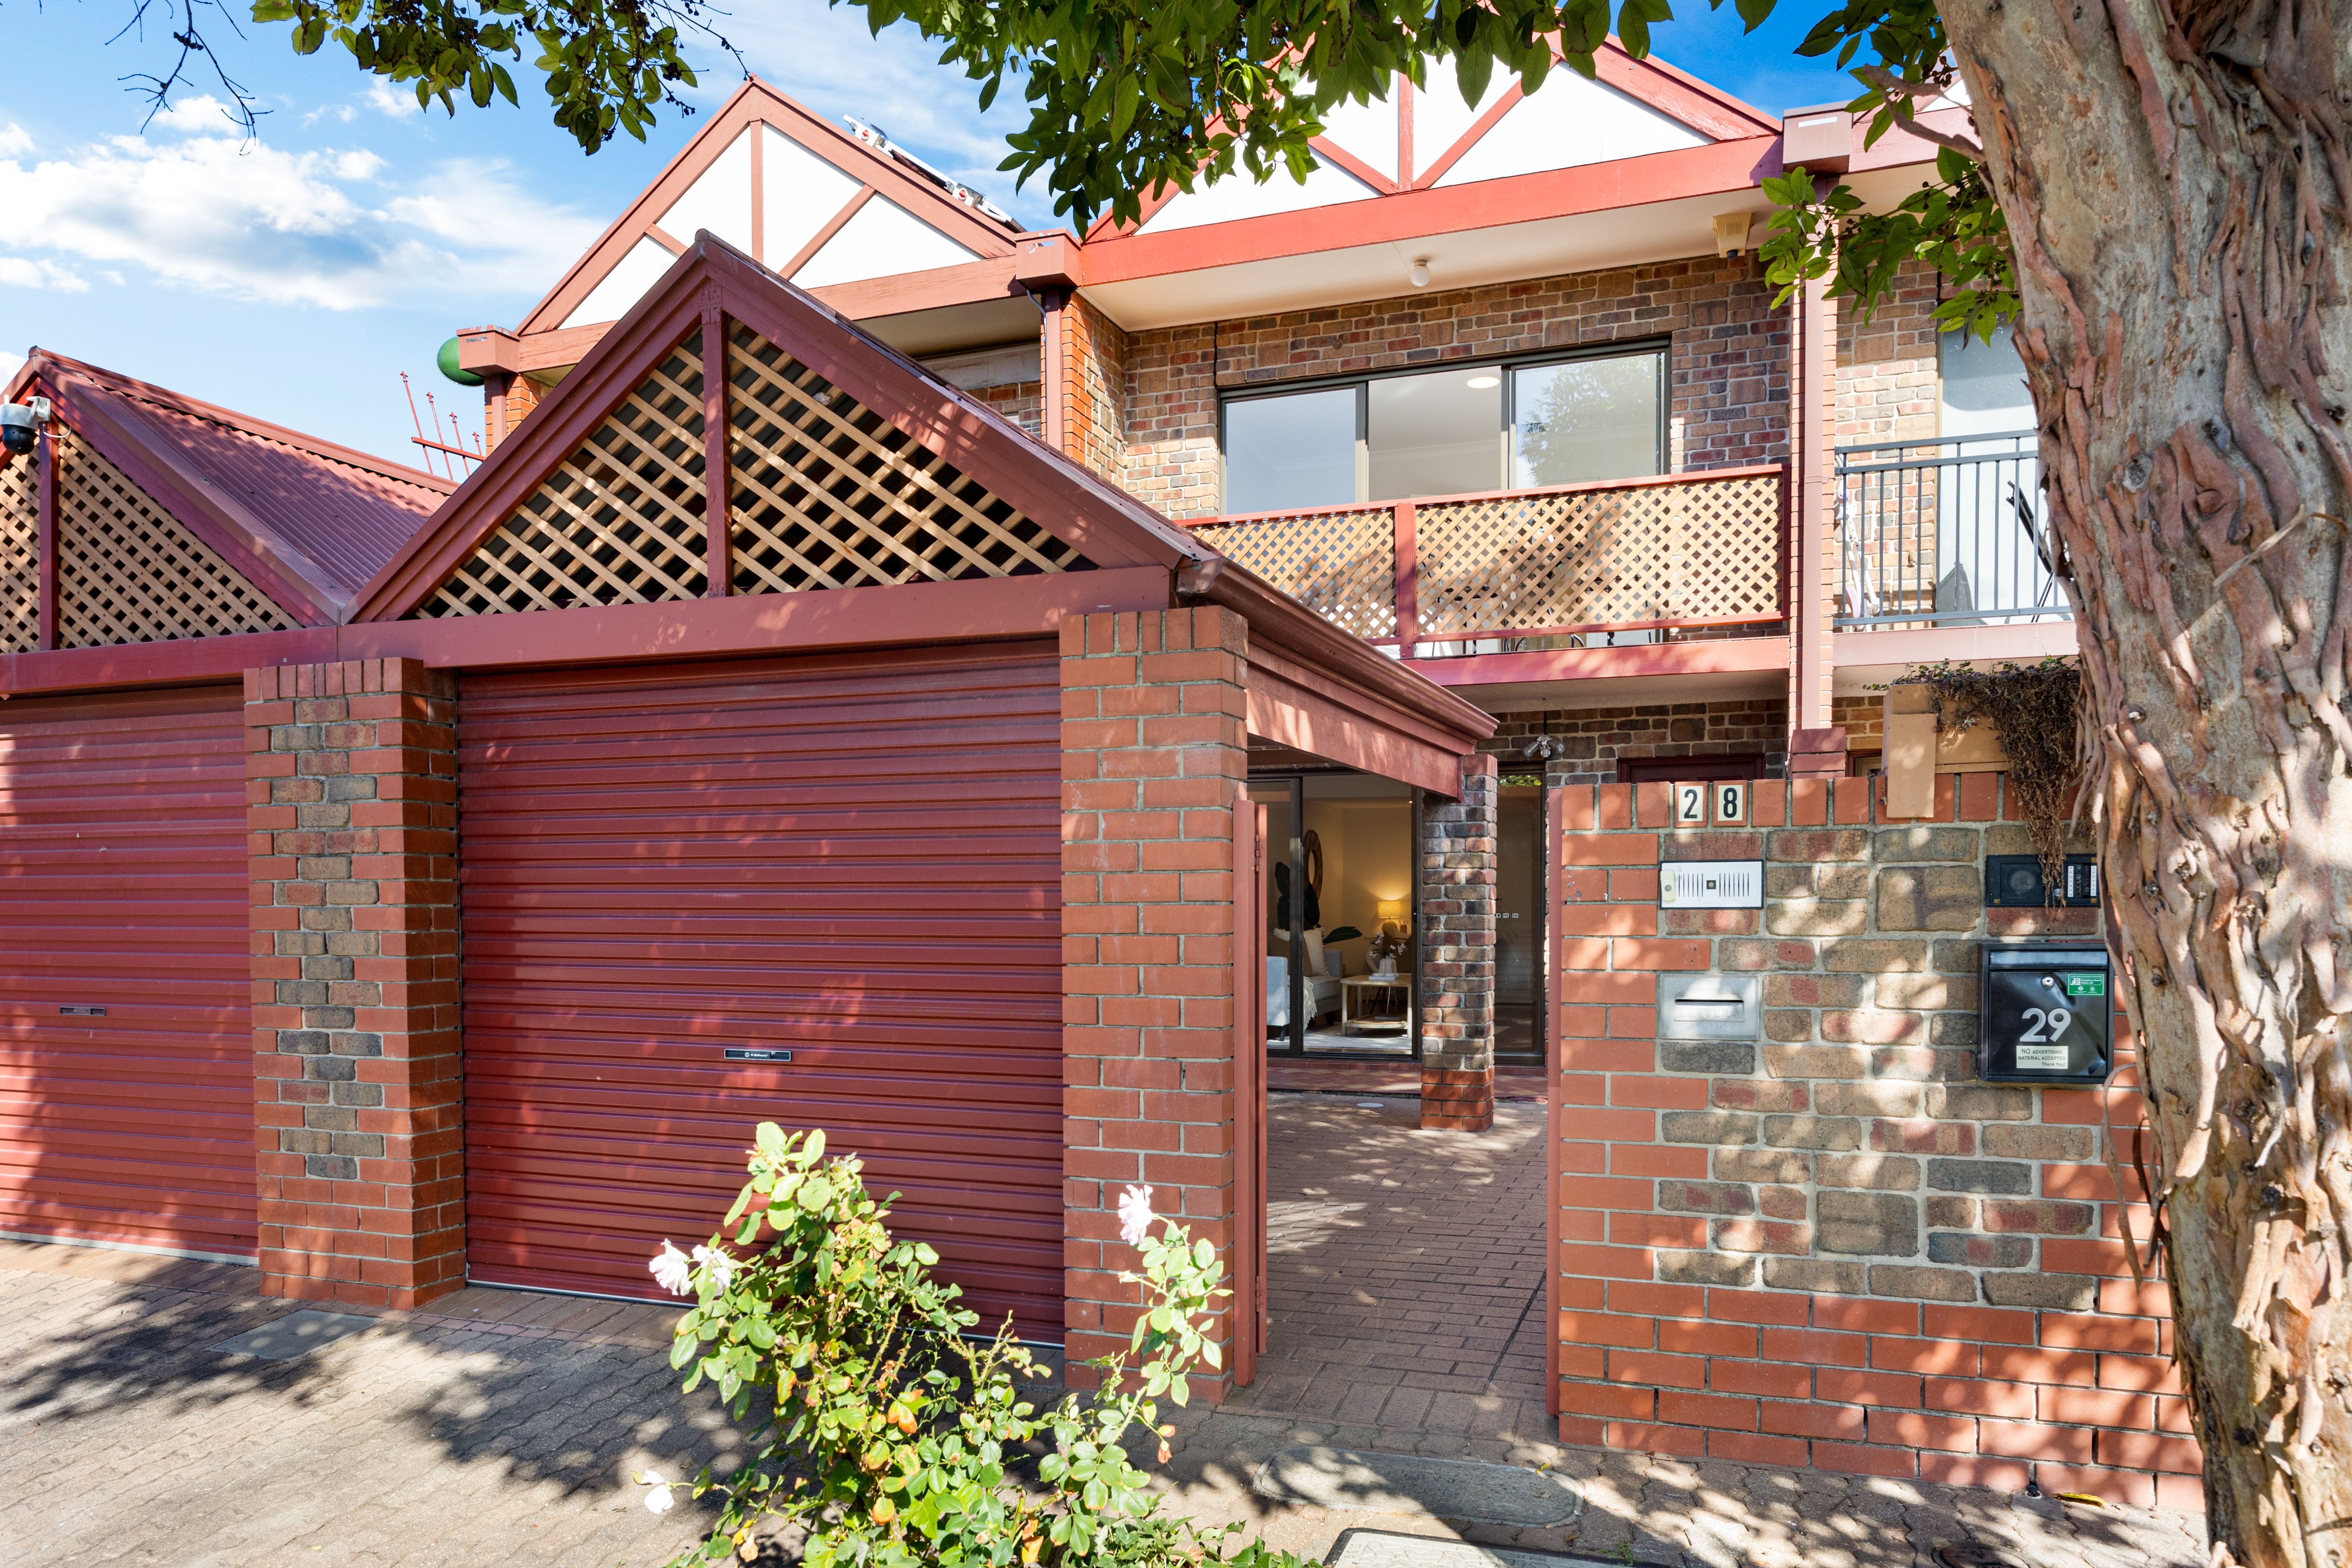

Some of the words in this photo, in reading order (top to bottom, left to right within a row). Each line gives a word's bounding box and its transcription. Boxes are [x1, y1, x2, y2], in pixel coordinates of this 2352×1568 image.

[1684, 787, 1737, 818] 28
[1680, 1008, 1739, 1018] LETTERS
[2019, 1008, 2071, 1042] 29
